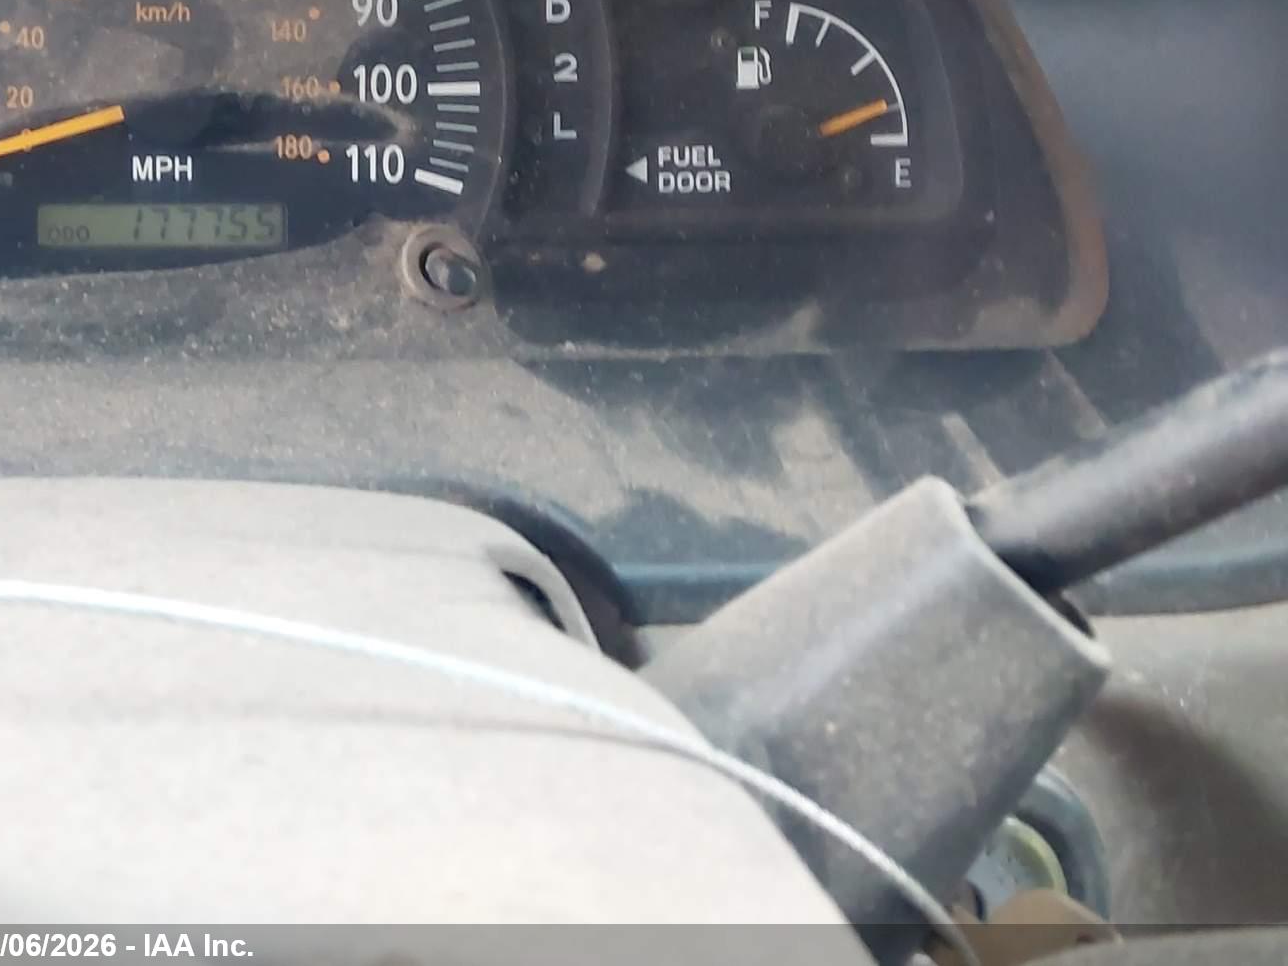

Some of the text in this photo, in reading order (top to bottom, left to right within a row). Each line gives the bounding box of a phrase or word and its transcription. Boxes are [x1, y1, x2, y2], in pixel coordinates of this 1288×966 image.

[135, 2, 191, 24] km/h
[754, 0, 772, 29] F
[15, 27, 45, 50] 40
[271, 19, 306, 43] 140
[553, 54, 578, 82] 2
[282, 77, 319, 99] 160
[353, 65, 417, 104] 100
[6, 87, 33, 109] 20
[554, 113, 577, 140] L
[275, 136, 312, 159] 180
[658, 147, 721, 168] FUEL
[132, 156, 193, 182] MPH
[346, 144, 404, 184] 110
[895, 159, 911, 189] E
[658, 172, 731, 193] DOOR
[132, 206, 276, 242] 177755
